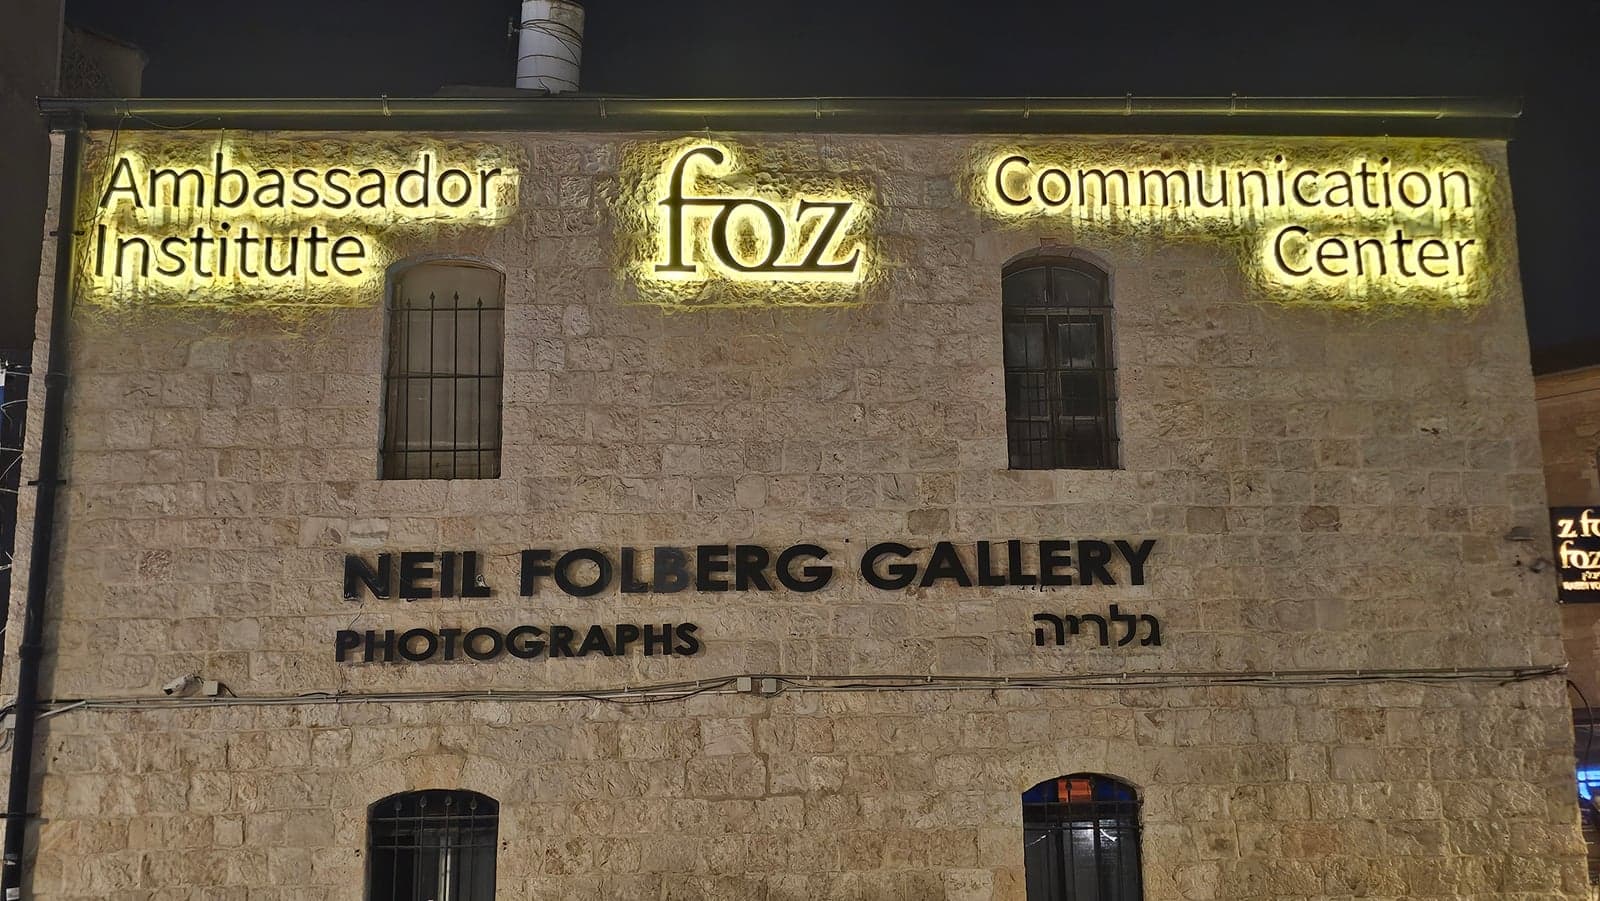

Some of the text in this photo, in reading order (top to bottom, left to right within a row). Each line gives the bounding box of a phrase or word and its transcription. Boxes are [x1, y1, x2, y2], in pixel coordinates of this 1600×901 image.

[98, 153, 502, 209] Ambassador
[994, 154, 1473, 208] Communication
[655, 147, 860, 272] foz
[94, 222, 365, 278] Institute
[1274, 225, 1475, 278] Center
[343, 539, 1157, 599] NEIL FOLBERG GALLERY
[335, 622, 700, 662] PHOTOGRAPHS
[1033, 603, 1162, 647] גלריה
